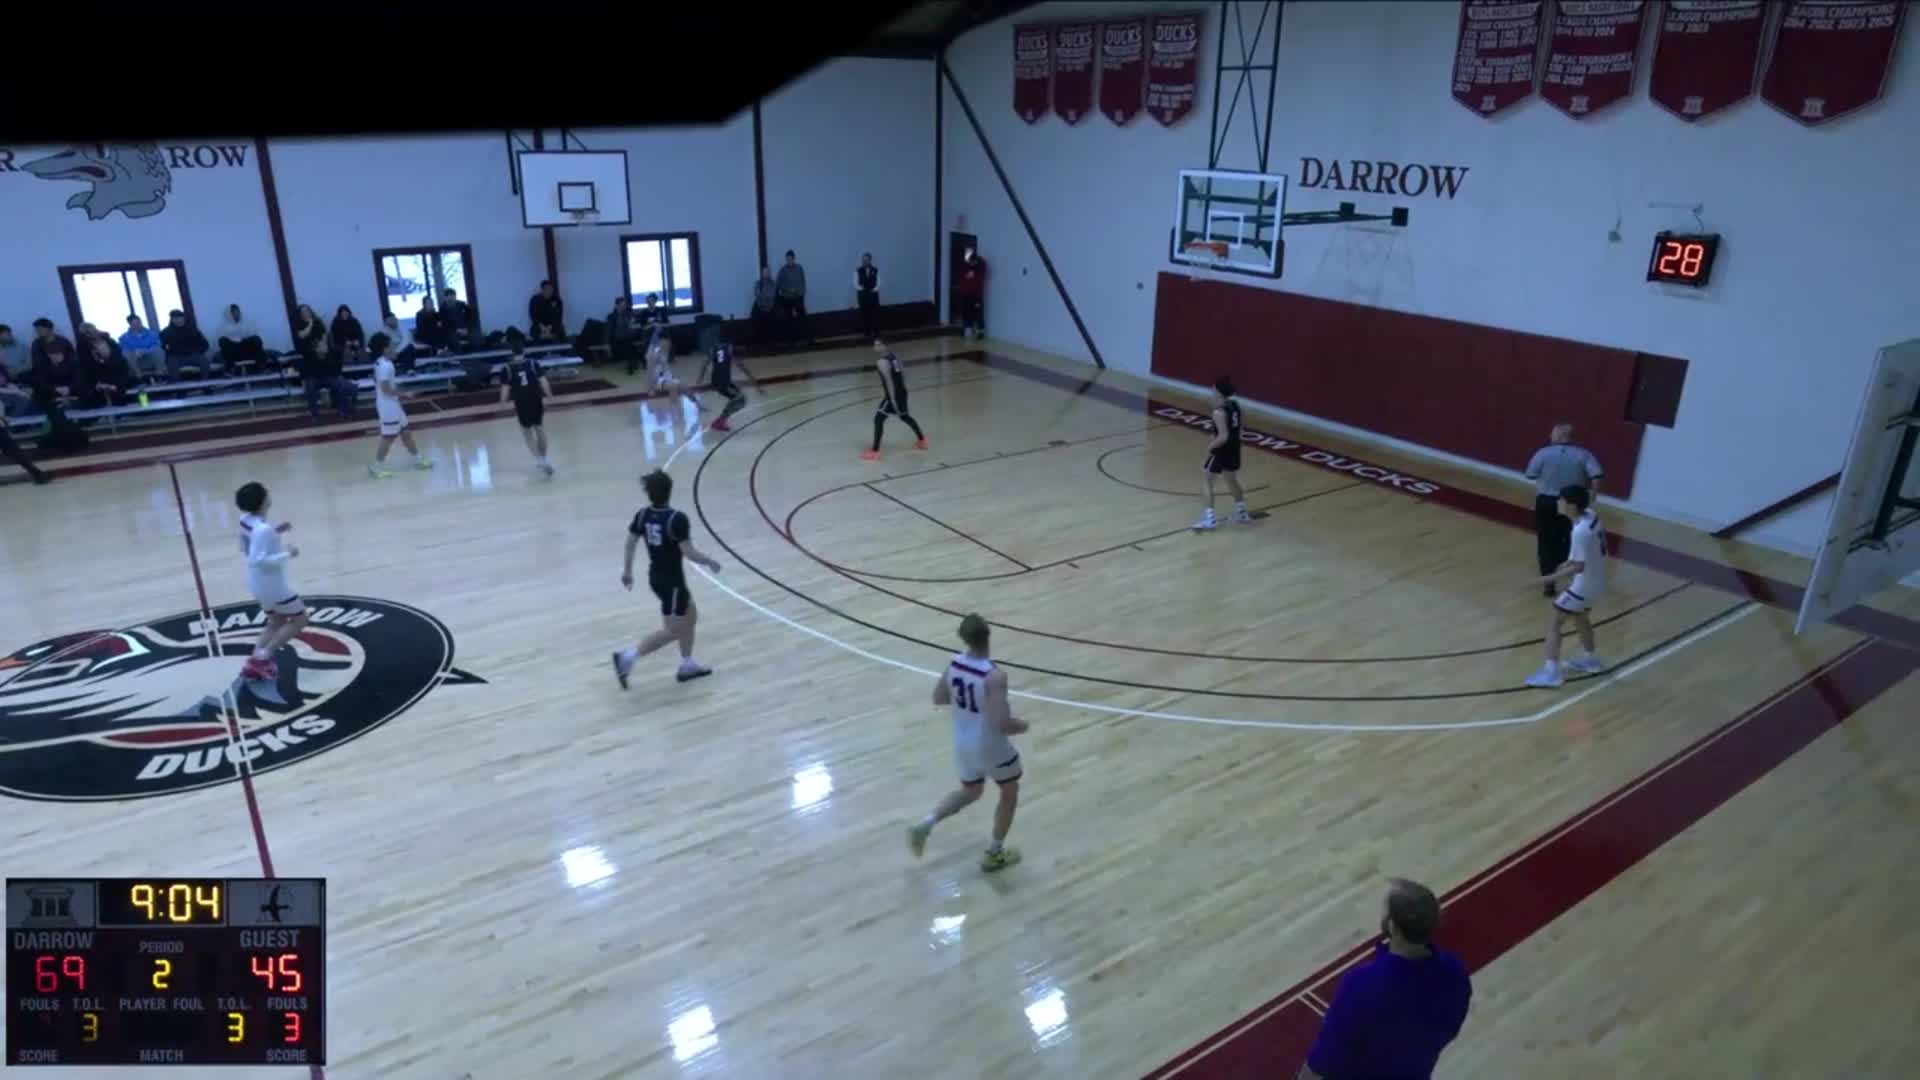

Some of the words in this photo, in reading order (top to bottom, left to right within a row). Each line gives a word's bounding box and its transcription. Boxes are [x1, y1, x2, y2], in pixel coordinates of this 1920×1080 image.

[1060, 32, 1092, 48] DUCKS
[1106, 28, 1142, 45] DUCKS
[1156, 24, 1196, 41] DUCKS
[1299, 157, 1470, 200] DARROW
[1659, 241, 1704, 276] 28
[1300, 450, 1441, 495] DUCKS
[189, 606, 385, 636] DAOW
[951, 677, 980, 713] 31
[136, 714, 337, 781] DUCKS
